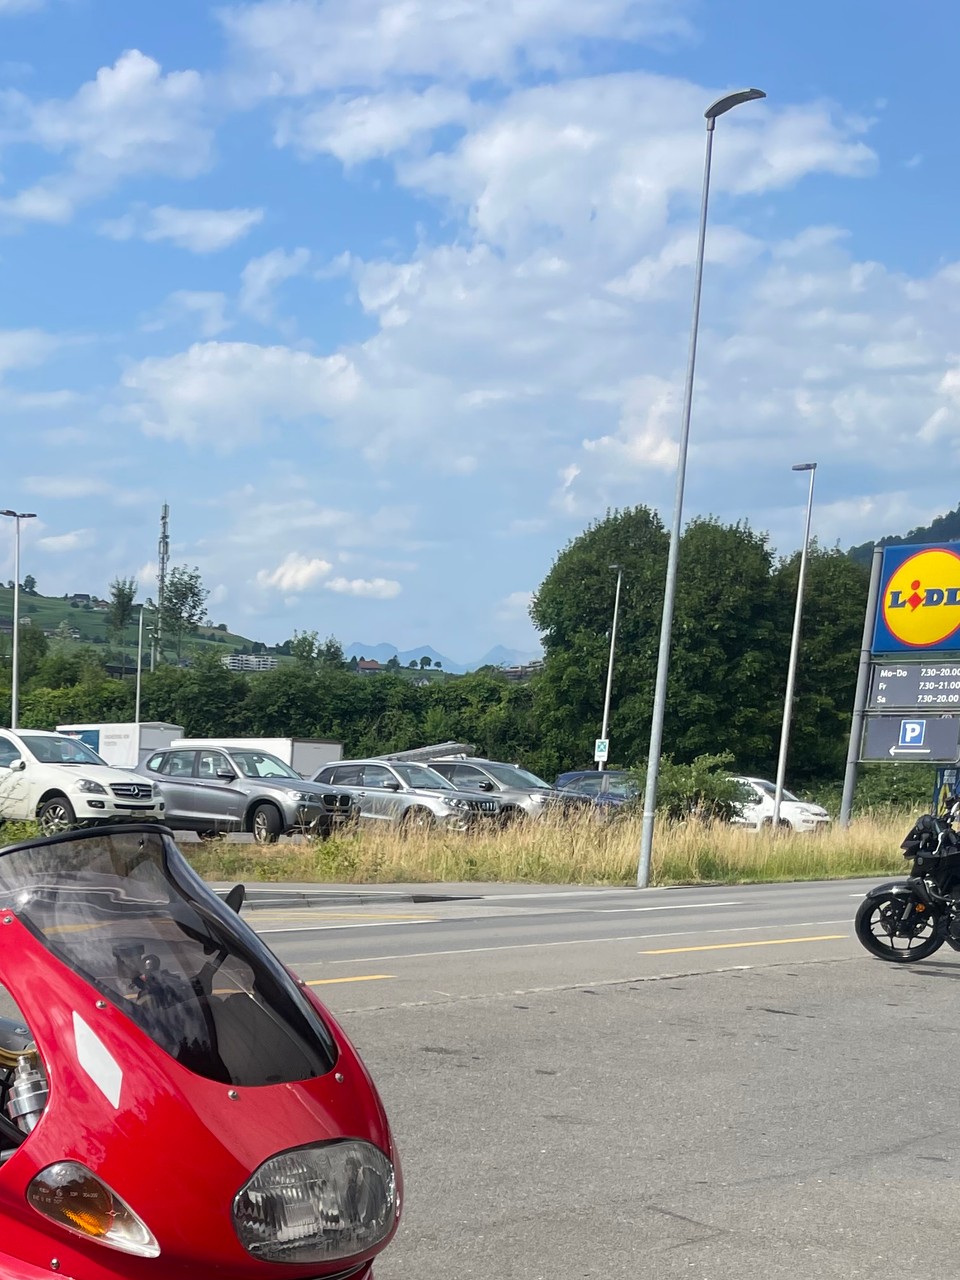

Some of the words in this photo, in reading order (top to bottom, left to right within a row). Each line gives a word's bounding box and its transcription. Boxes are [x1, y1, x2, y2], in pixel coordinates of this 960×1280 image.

[880, 669, 907, 677] Mo-Do
[878, 682, 887, 690] Fr
[919, 681, 960, 689] 7.30-21.00
[876, 695, 886, 703] Sa
[917, 694, 959, 703] 7.30-20.00
[905, 723, 921, 742] P
